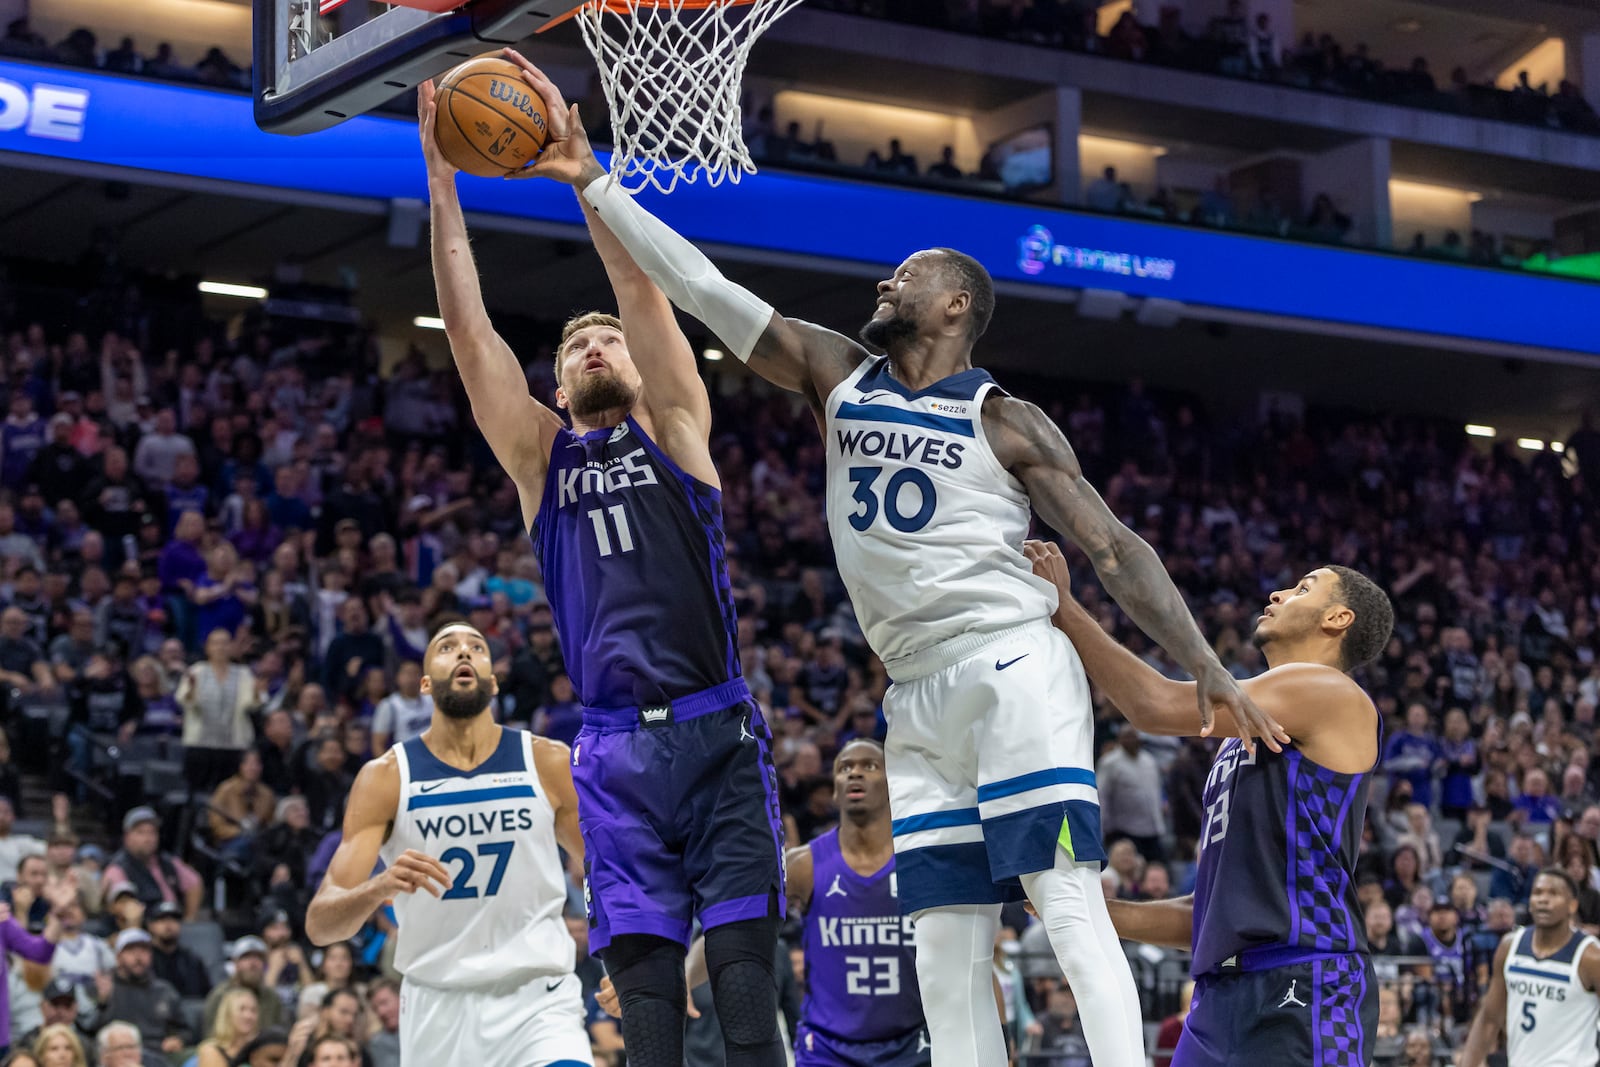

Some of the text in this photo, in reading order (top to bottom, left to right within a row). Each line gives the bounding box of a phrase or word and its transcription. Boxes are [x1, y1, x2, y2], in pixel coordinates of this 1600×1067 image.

[489, 79, 546, 134] Wilson
[938, 403, 967, 414] sezzle
[837, 430, 966, 470] WOLVES
[558, 447, 658, 509] KNGS
[848, 466, 937, 533] 30
[587, 504, 634, 557] 11
[415, 808, 532, 841] WOLVES
[440, 840, 515, 900] 27
[845, 956, 900, 996] 23
[1521, 1001, 1537, 1034] 5
